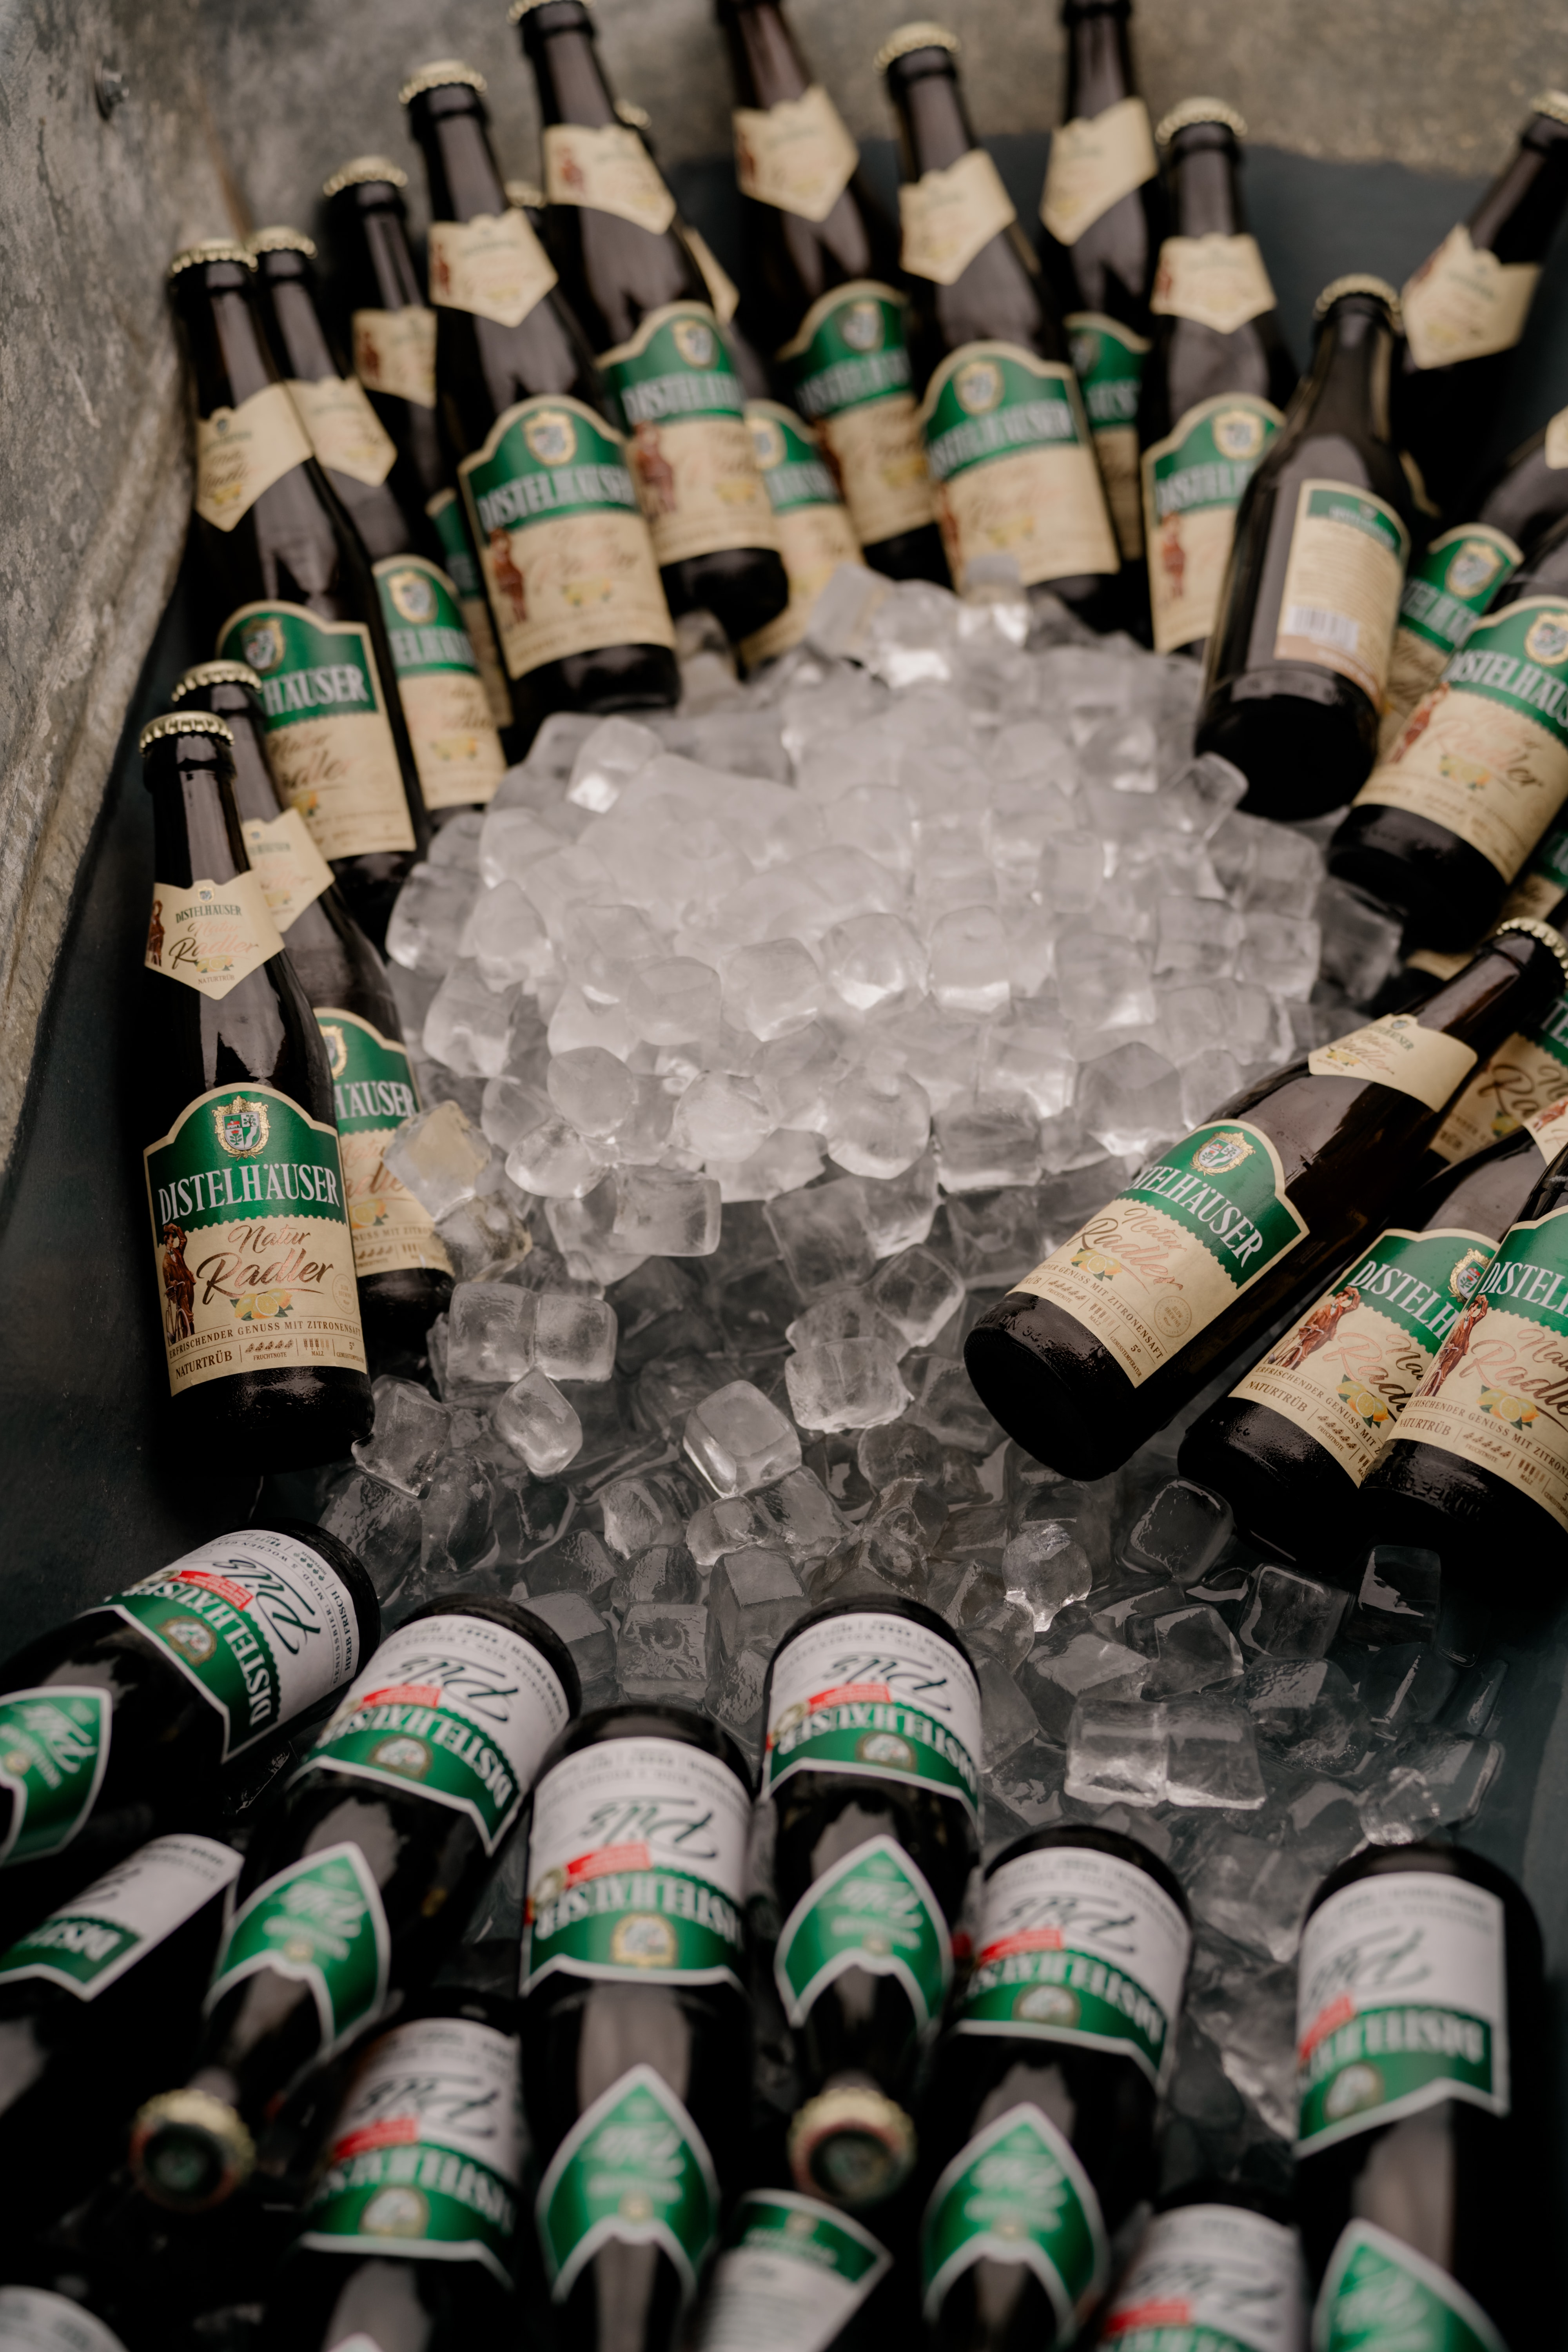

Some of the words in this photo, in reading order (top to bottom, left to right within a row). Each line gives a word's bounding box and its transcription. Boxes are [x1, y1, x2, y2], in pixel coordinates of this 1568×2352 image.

[176, 904, 242, 923] DISTELHÄUSER
[187, 919, 242, 937] Natur
[169, 935, 259, 970] Radler
[198, 974, 235, 984] NATURTRÜB
[334, 1081, 420, 1119] HÄUSER
[158, 1163, 339, 1225] DISTELHÄUSER
[227, 1224, 311, 1253] Natur
[1122, 1208, 1187, 1252] Natur
[1066, 1218, 1183, 1294] Radler
[196, 1248, 334, 1305] Radler
[1047, 1288, 1073, 1303] FRUCHTNOTE
[1478, 1261, 1568, 1318] DISTEL
[1058, 1267, 1090, 1284] GENUSS
[1090, 1283, 1109, 1296] MIT
[1108, 1296, 1163, 1359] ZITRONENSAFT
[1347, 1261, 1460, 1341] DISTELH
[169, 1329, 233, 1359] ERFRISCHENDER
[237, 1322, 280, 1335] GENUSS
[285, 1321, 303, 1329] MIT
[307, 1321, 361, 1336] ZITRONENSAFT
[1089, 1315, 1101, 1327] MALZ
[175, 1350, 232, 1379] NATURTRÜB
[253, 1352, 287, 1360] FRUCHTNOTE
[1110, 1336, 1142, 1377] GENUSSTEMPERATUR
[1131, 1345, 1141, 1353] 5°
[1246, 1381, 1308, 1412] NATURTRÜB
[1256, 1367, 1324, 1399] ERFRISCHENDER
[1326, 1397, 1360, 1429] GENUSS
[1360, 1428, 1376, 1447] MIT
[1317, 1425, 1344, 1452] FRUCHTNOTE
[1397, 1418, 1452, 1436] NATURTRÜB
[1468, 1412, 1509, 1436] GENUSS
[1512, 1433, 1532, 1450] MIT
[212, 1553, 321, 1656] Pils
[331, 1590, 350, 1635] FRISCH
